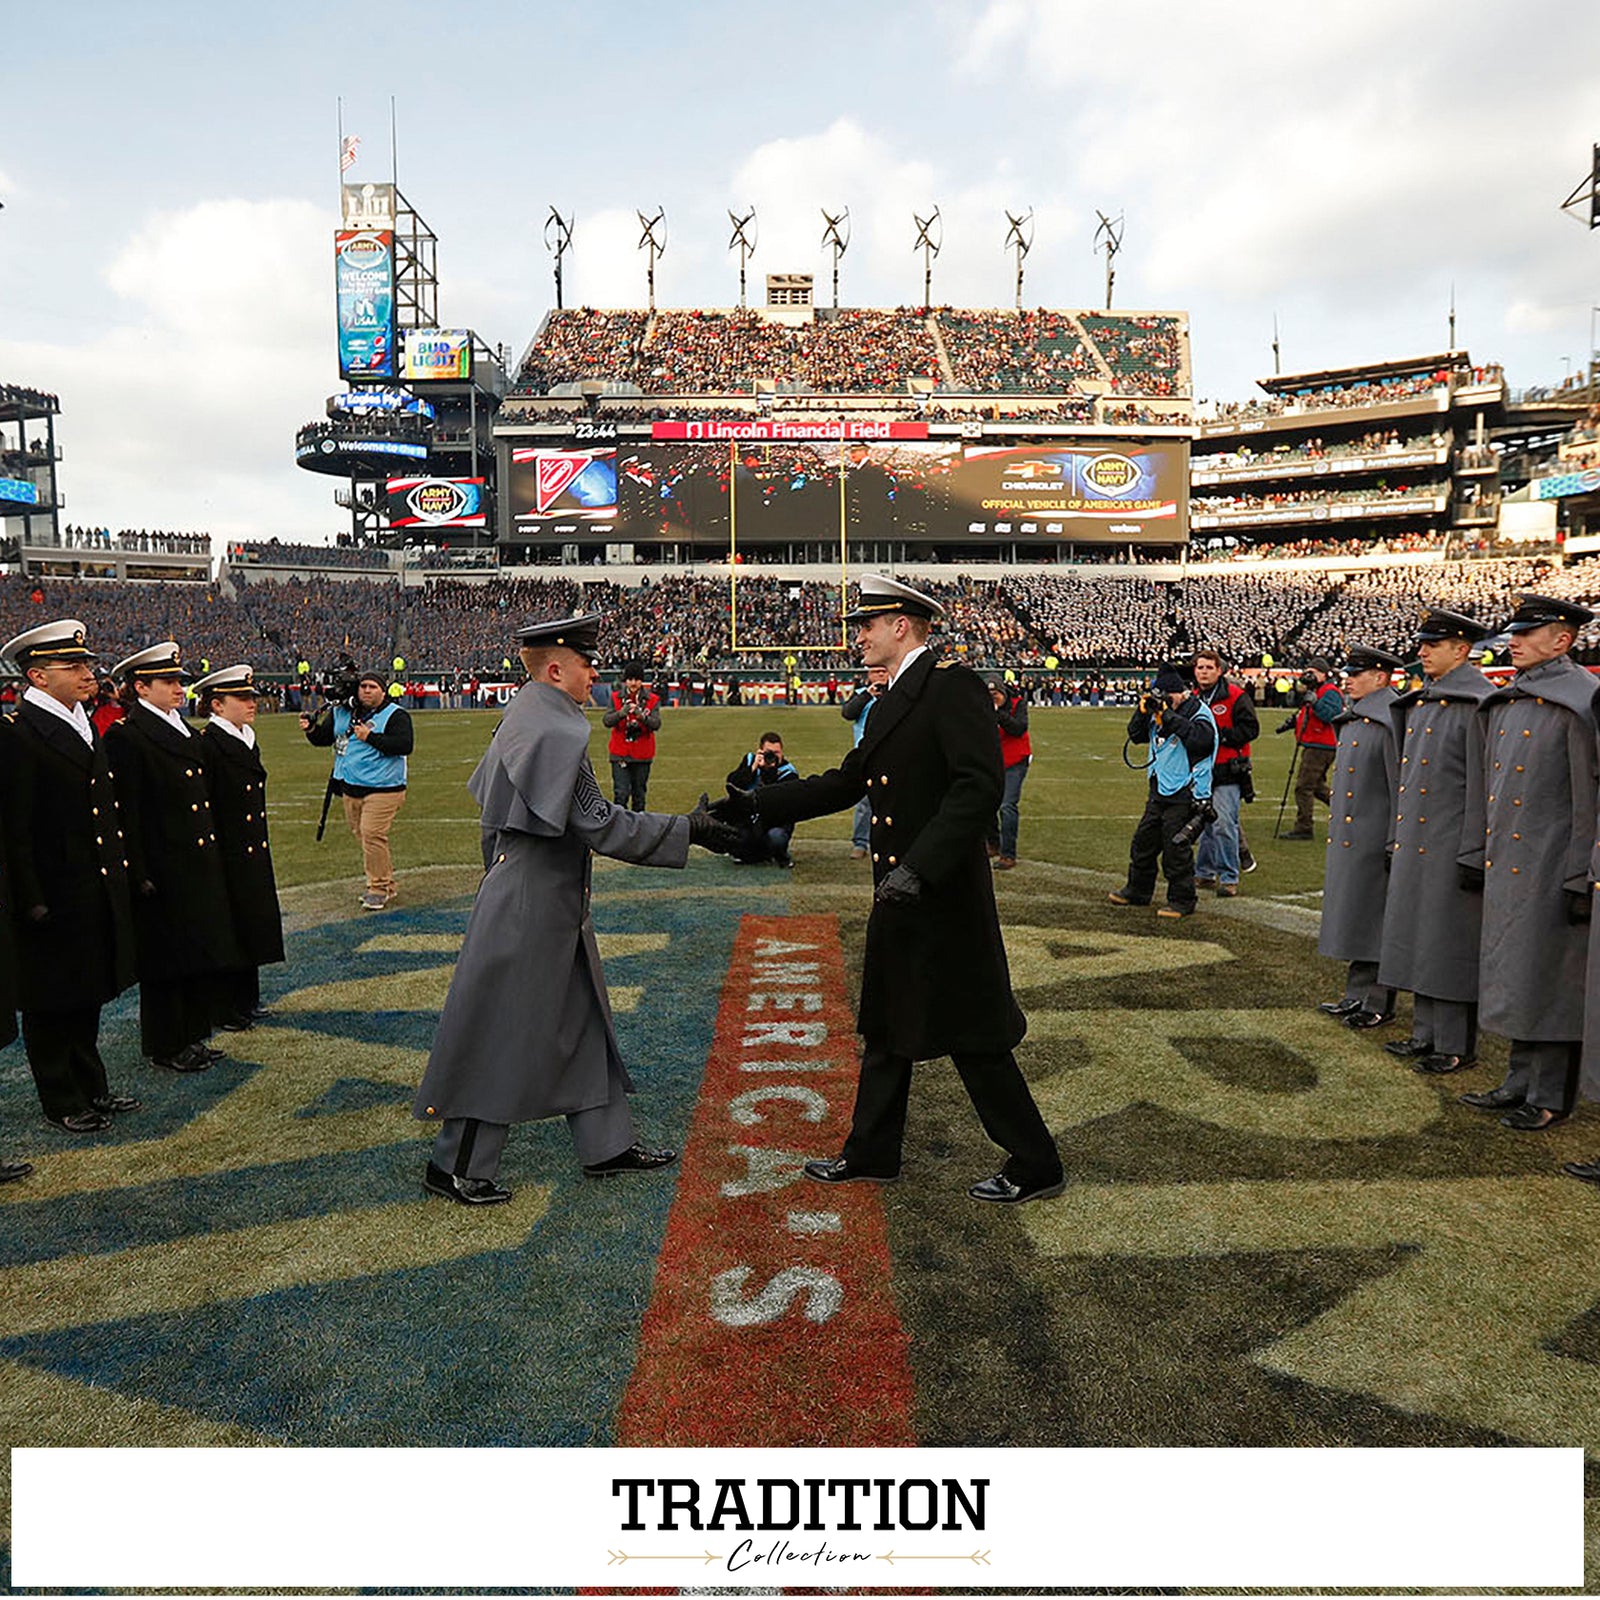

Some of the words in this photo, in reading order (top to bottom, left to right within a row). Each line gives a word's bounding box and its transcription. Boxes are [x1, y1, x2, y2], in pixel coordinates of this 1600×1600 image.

[341, 271, 389, 282] WELCOME
[418, 342, 450, 354] BUD
[413, 354, 457, 367] LIGHT
[707, 421, 767, 438] Lincoln
[772, 421, 845, 439] Financial
[850, 421, 890, 439] Field
[338, 441, 384, 452] Welcome
[1096, 462, 1127, 471] ARMY
[1096, 474, 1127, 485] NAVY
[1002, 482, 1064, 491] CHEVROLET
[421, 487, 452, 498] ARMY
[422, 500, 452, 511] NAVY
[981, 500, 1023, 510] OFFICIAL
[1026, 500, 1066, 510] VEHICLE
[1068, 500, 1080, 510] OF
[1079, 500, 1133, 510] AMERICA'S
[1134, 500, 1162, 510] GAME
[710, 937, 845, 1326] AMERICA'S
